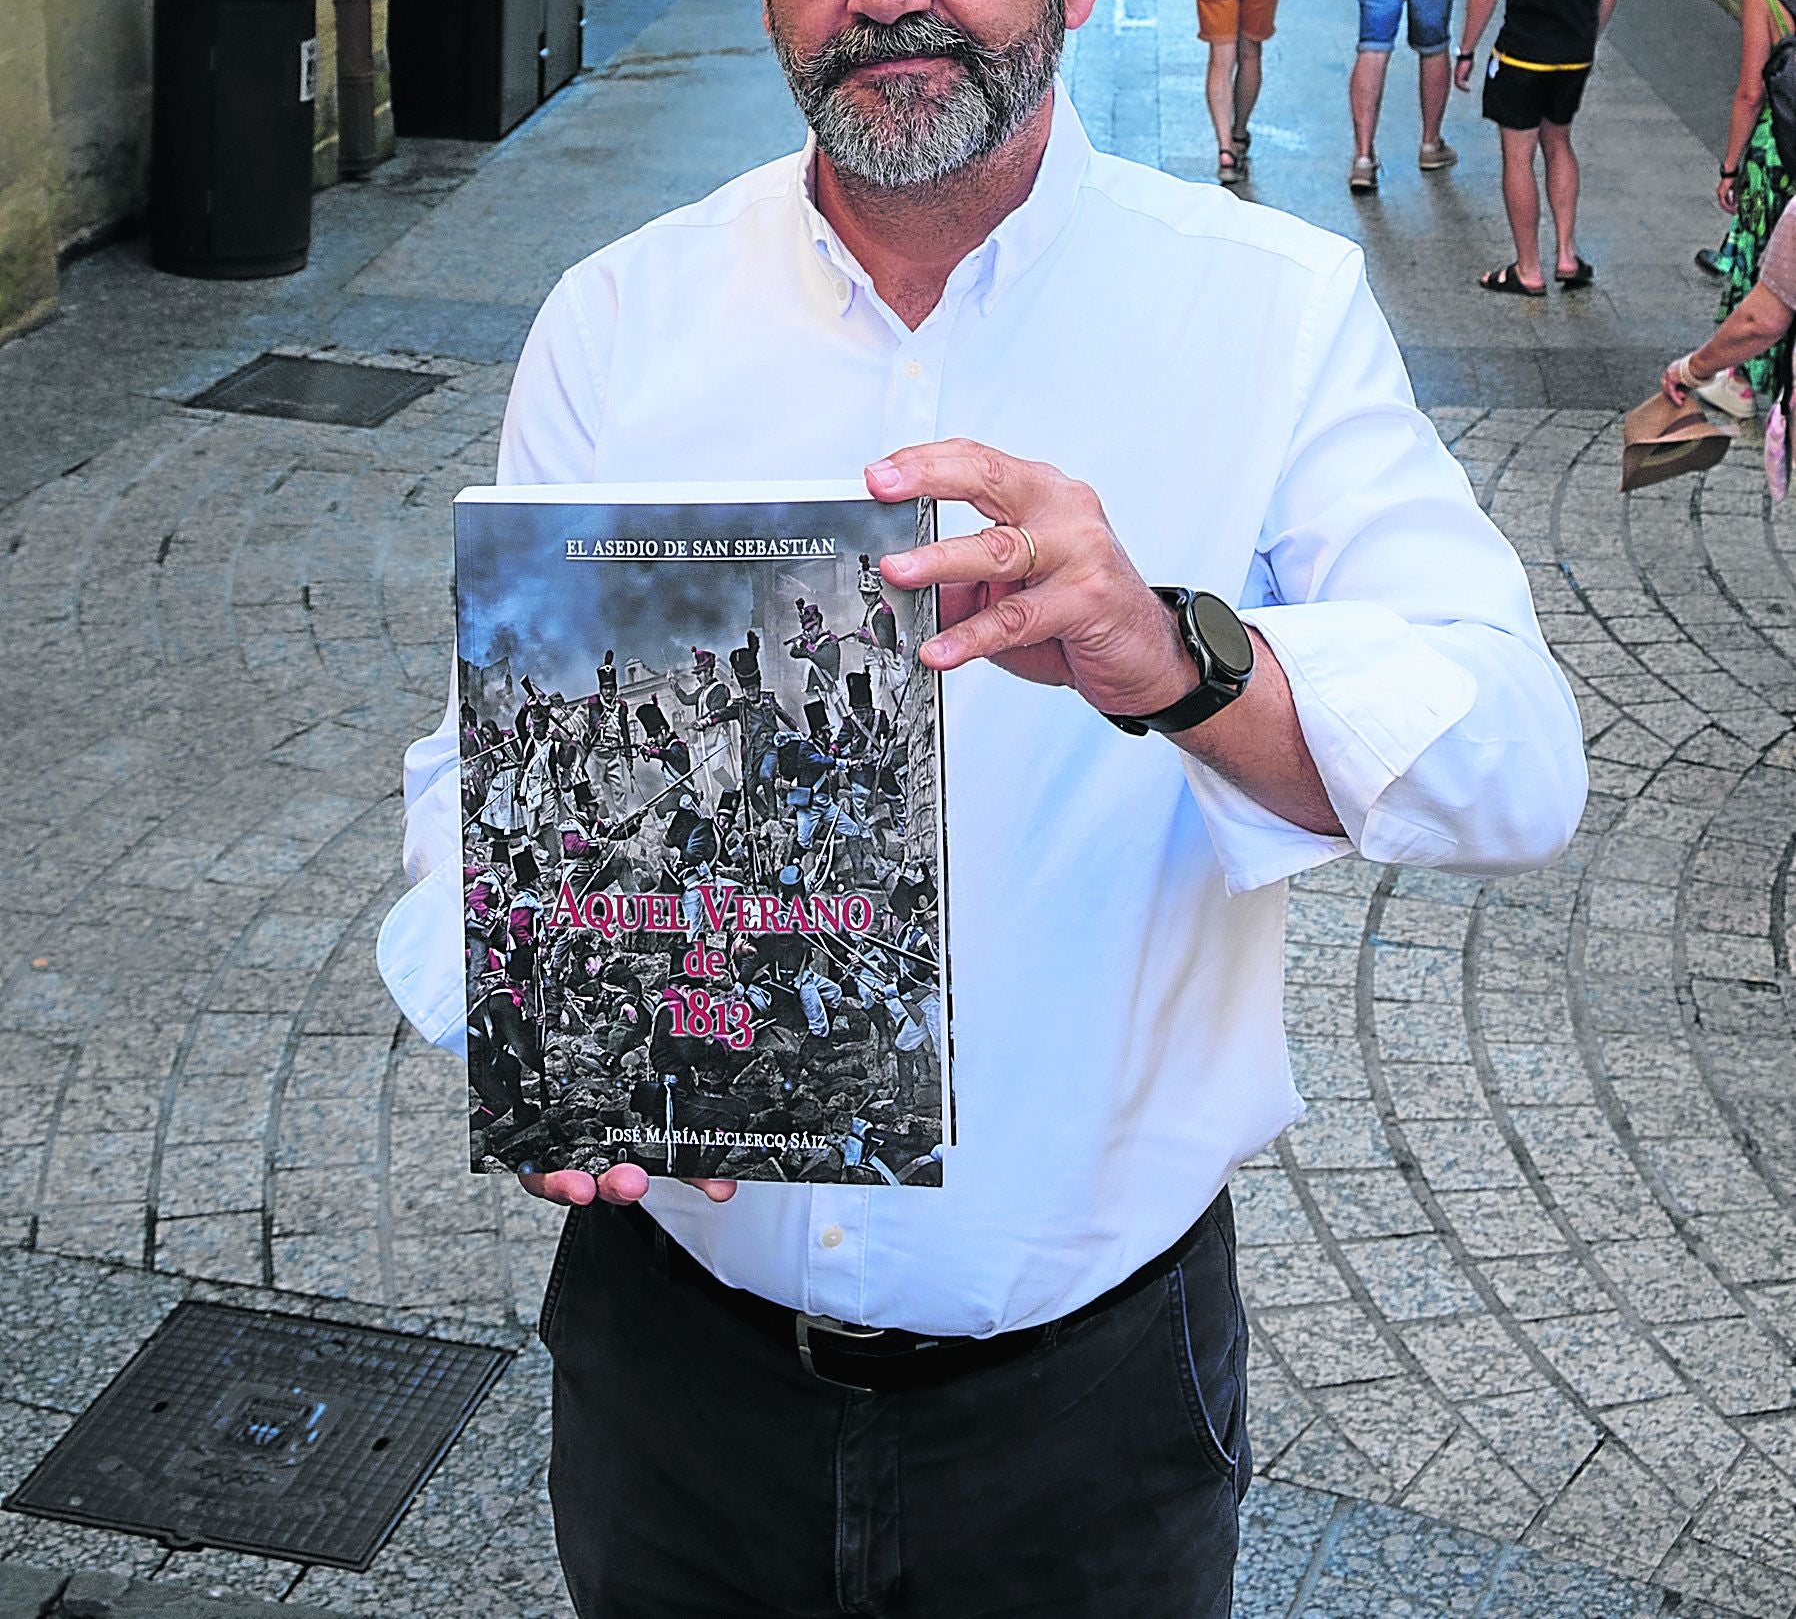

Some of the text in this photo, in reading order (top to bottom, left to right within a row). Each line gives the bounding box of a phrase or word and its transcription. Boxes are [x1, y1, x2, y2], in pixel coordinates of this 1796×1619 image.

[566, 538, 836, 556] EL ASEDIO DE SAN SEBASTIAN
[684, 940, 726, 978] de
[669, 990, 754, 1050] 1813
